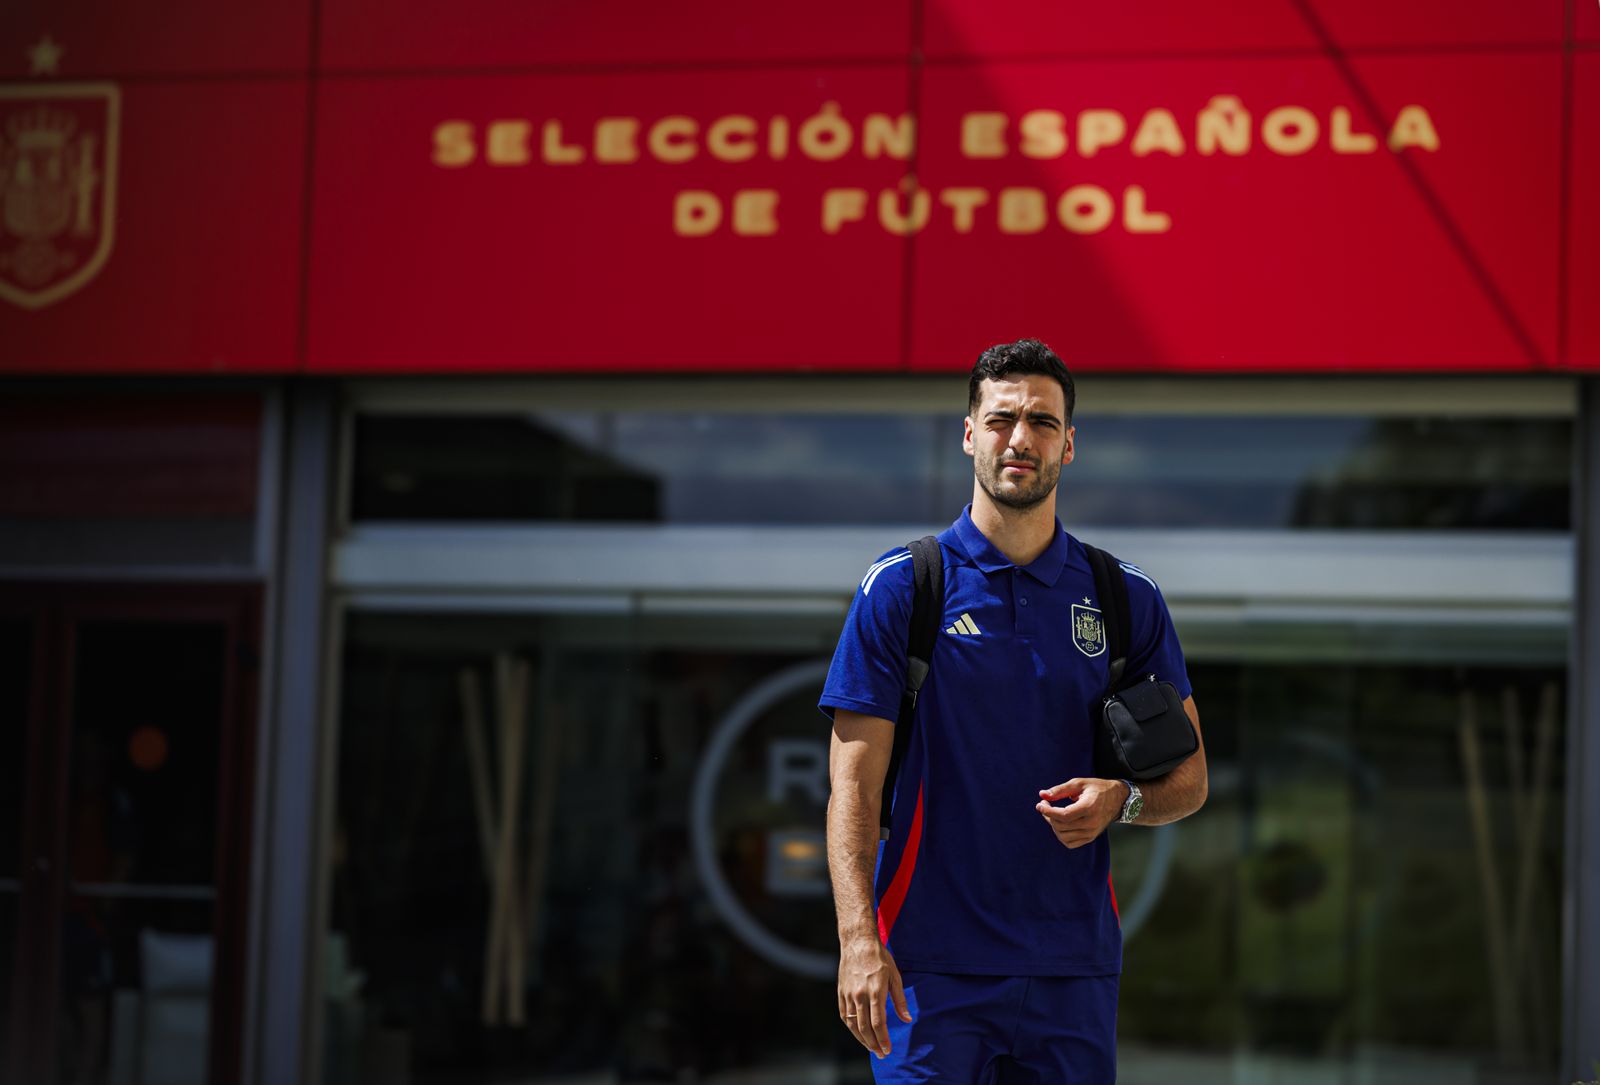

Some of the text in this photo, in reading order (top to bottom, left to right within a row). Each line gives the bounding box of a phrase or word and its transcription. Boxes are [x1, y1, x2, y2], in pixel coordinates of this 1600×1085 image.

[432, 95, 1440, 166] SELECCIÓN ESPAÑOLA
[673, 176, 1171, 236] DE FÚTBOL
